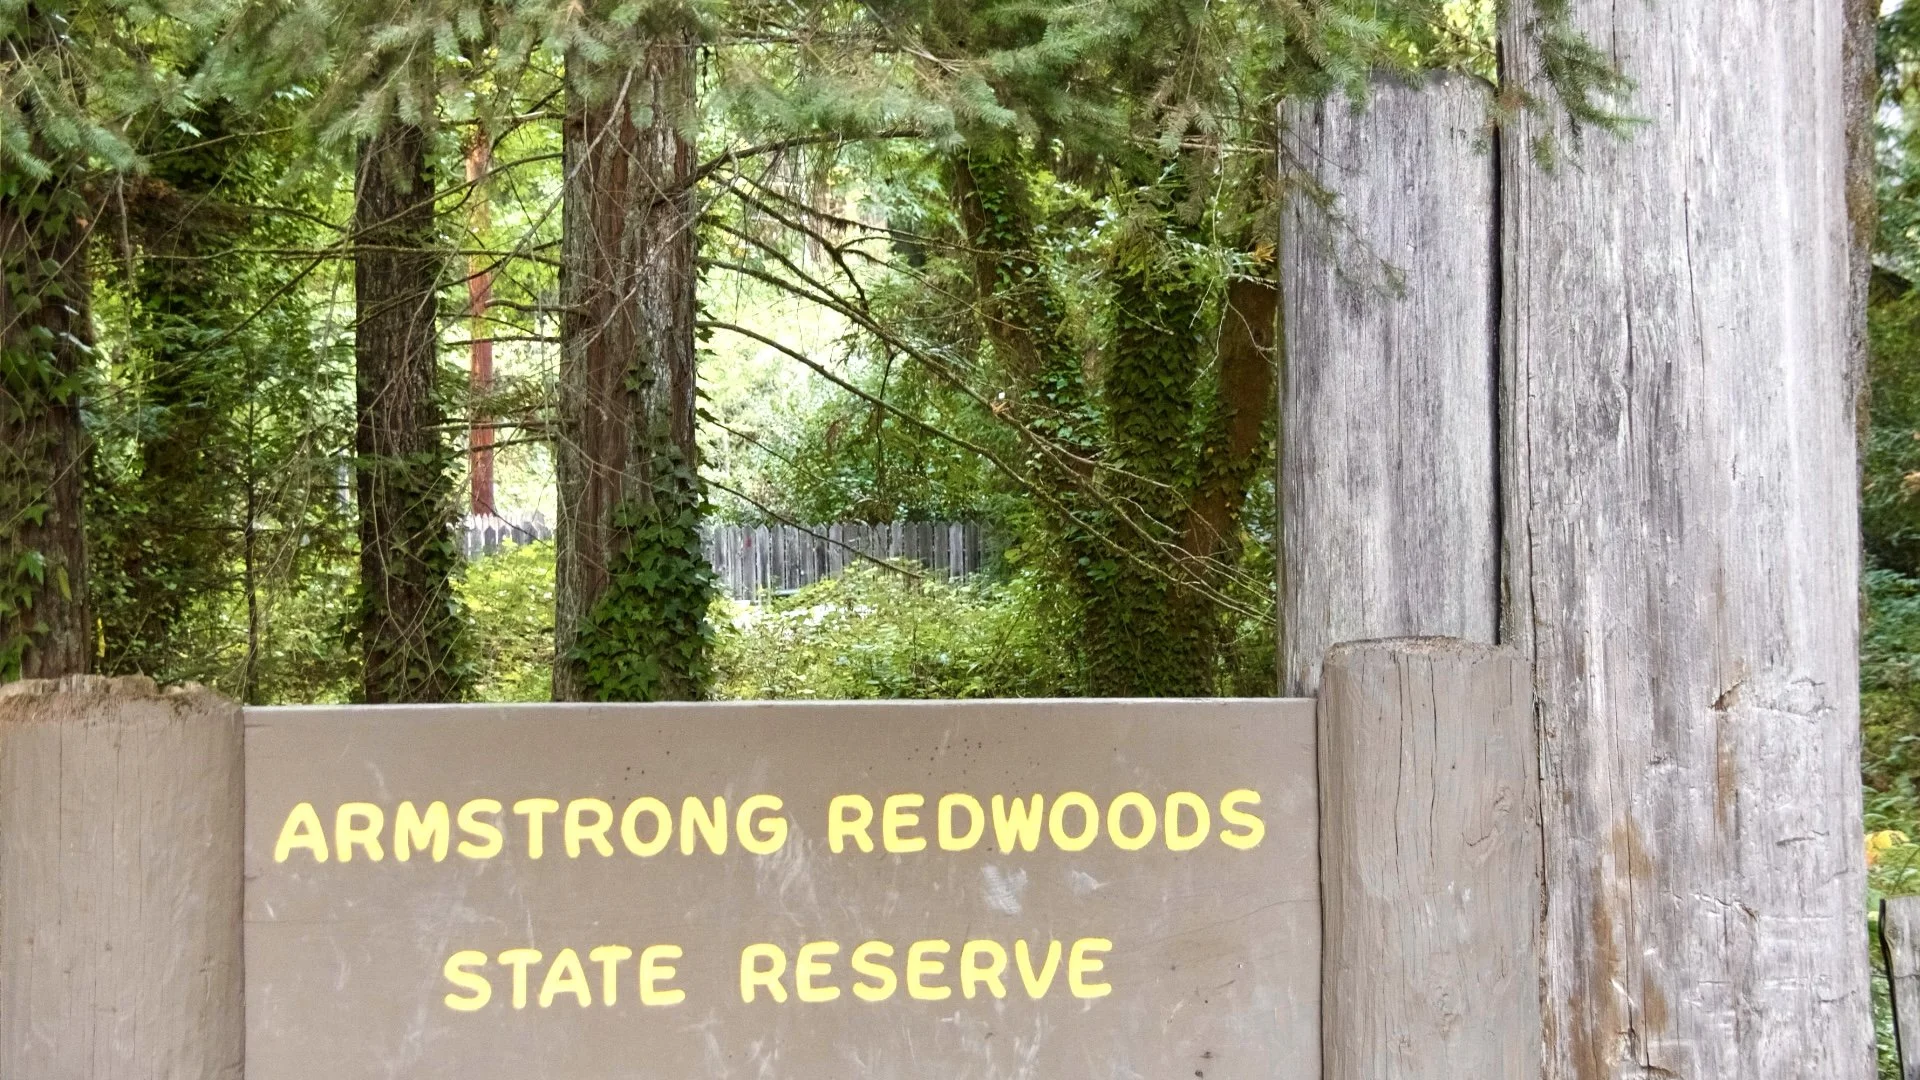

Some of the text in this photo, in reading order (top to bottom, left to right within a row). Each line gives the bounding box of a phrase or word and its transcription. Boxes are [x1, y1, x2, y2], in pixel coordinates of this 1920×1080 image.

[272, 788, 1265, 863] ARMSTRONG REDWOODS
[443, 937, 1113, 1010] STATE RESERVE
